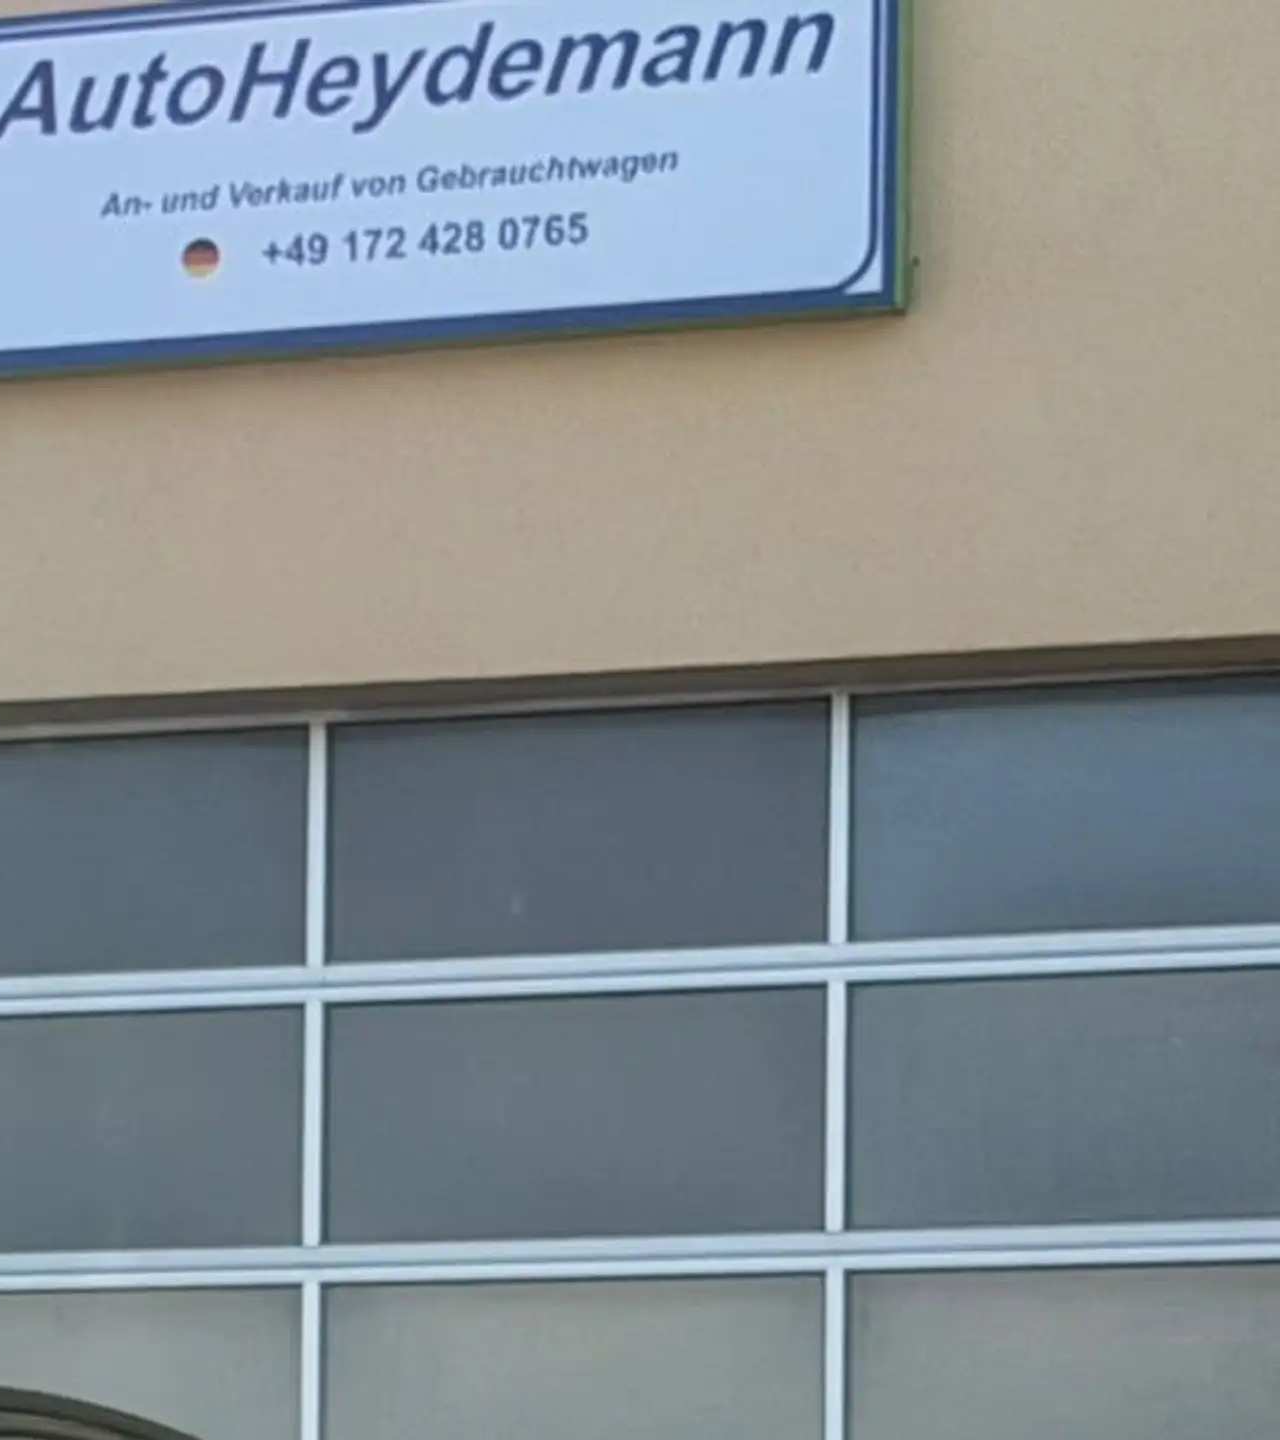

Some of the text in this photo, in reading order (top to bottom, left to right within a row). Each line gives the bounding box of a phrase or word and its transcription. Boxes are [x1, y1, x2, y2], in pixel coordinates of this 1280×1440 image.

[100, 149, 680, 218] An- und Verkauf von Gebrauchtwagen
[261, 211, 589, 266] +49 172 428 0765
